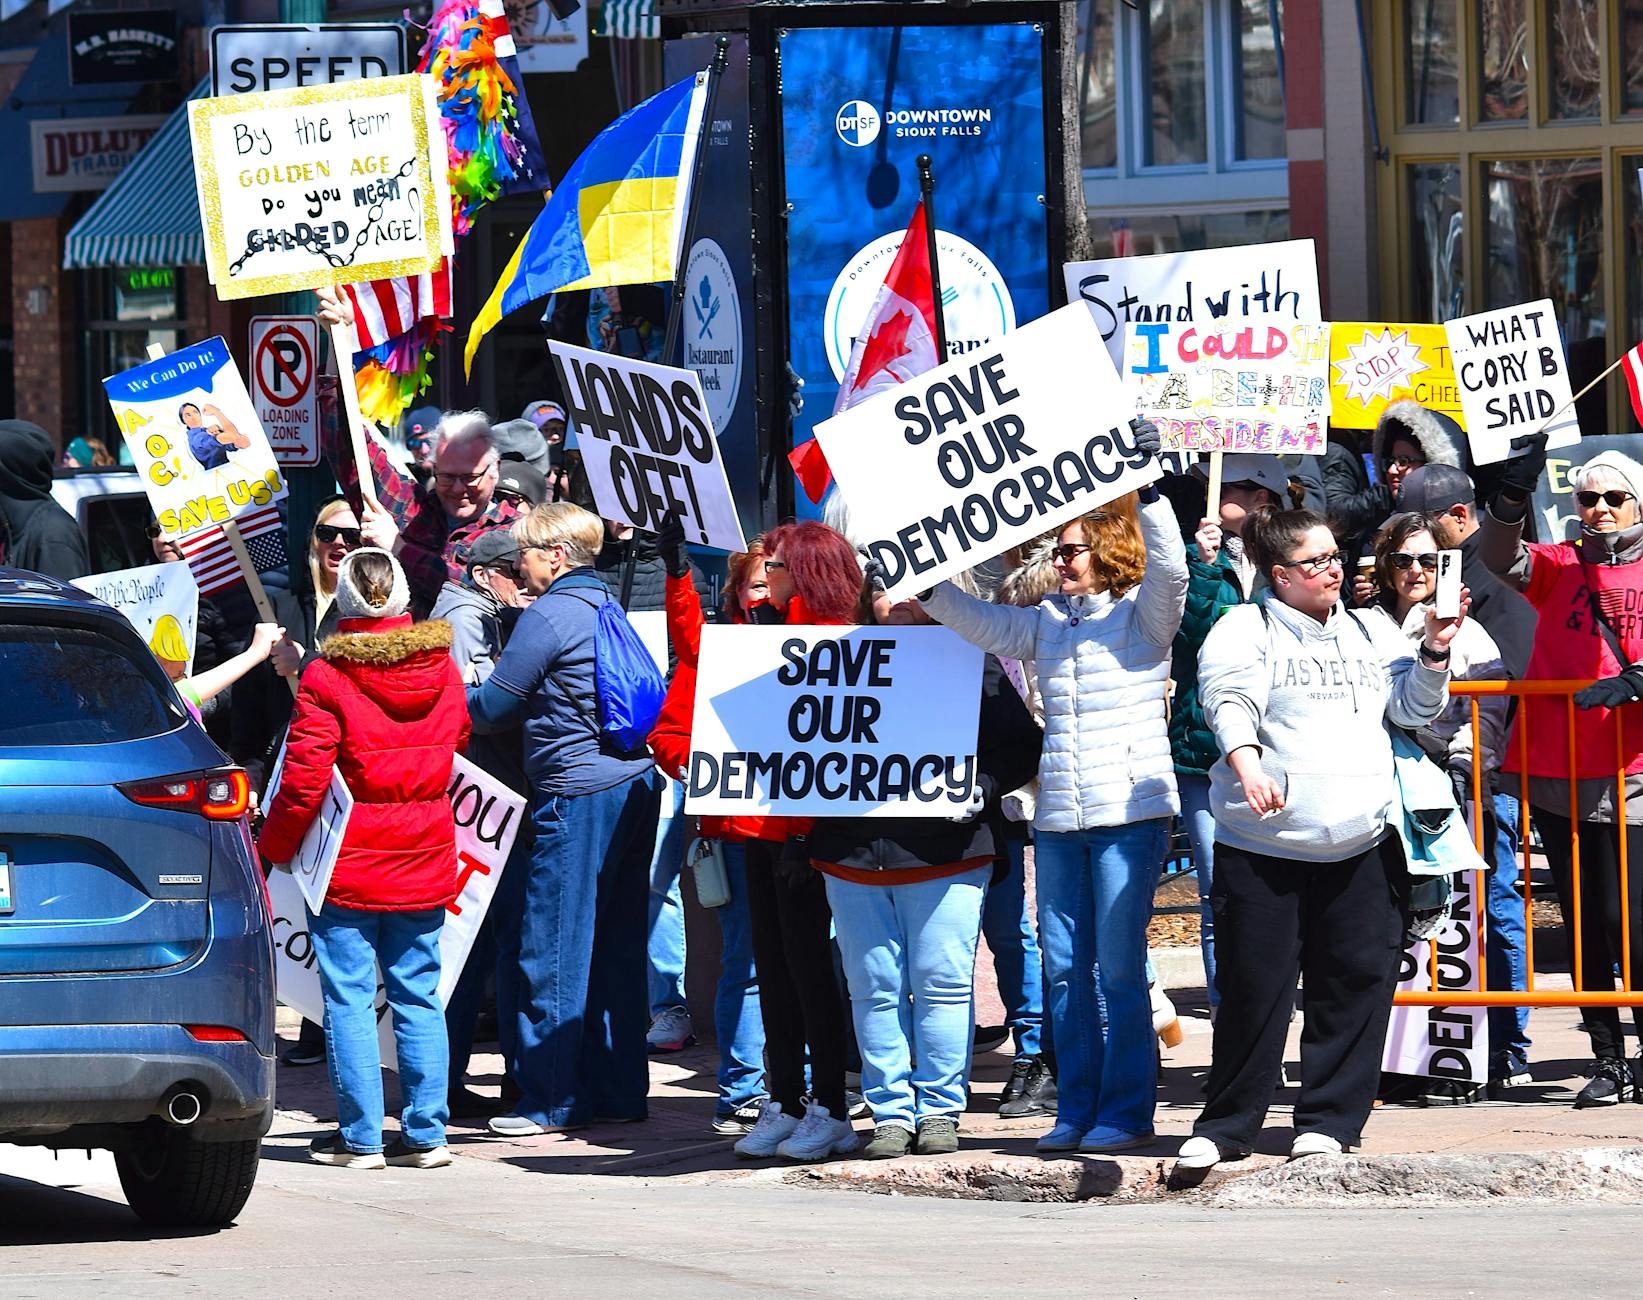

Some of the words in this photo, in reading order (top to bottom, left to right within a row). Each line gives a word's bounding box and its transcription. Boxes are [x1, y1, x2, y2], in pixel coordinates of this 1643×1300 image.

[230, 57, 388, 93] SPEED
[233, 124, 272, 156] By
[295, 115, 332, 146] the
[348, 109, 391, 139] term
[885, 109, 991, 124] DOWNTOWN
[896, 127, 936, 137] SIOUX
[942, 126, 981, 136] FALLS
[239, 160, 330, 188] GOLDEN
[350, 155, 391, 177] AGE
[304, 188, 341, 219] you
[246, 220, 350, 253] GILDED
[1205, 269, 1300, 320] with
[1131, 324, 1170, 375] I
[1355, 346, 1400, 387] STOP
[1461, 350, 1527, 392] CORY
[1537, 346, 1558, 378] B
[127, 379, 149, 394] We
[150, 369, 177, 384] Can
[178, 359, 198, 375] Do
[198, 351, 216, 368] It!
[1152, 372, 1192, 410] A
[262, 409, 309, 423] LOADING
[550, 352, 714, 465] HANDS
[893, 352, 1021, 446] SAVE
[272, 426, 301, 440] ZONE
[937, 413, 1038, 489] OUR
[157, 495, 231, 534] SAVE
[609, 445, 709, 546] OFF!
[866, 417, 1153, 590] DEMOCRACY
[777, 638, 896, 687] SAVE
[1271, 658, 1311, 690] LAS
[788, 694, 881, 744] OUR
[689, 751, 976, 803] DEMOCRACY
